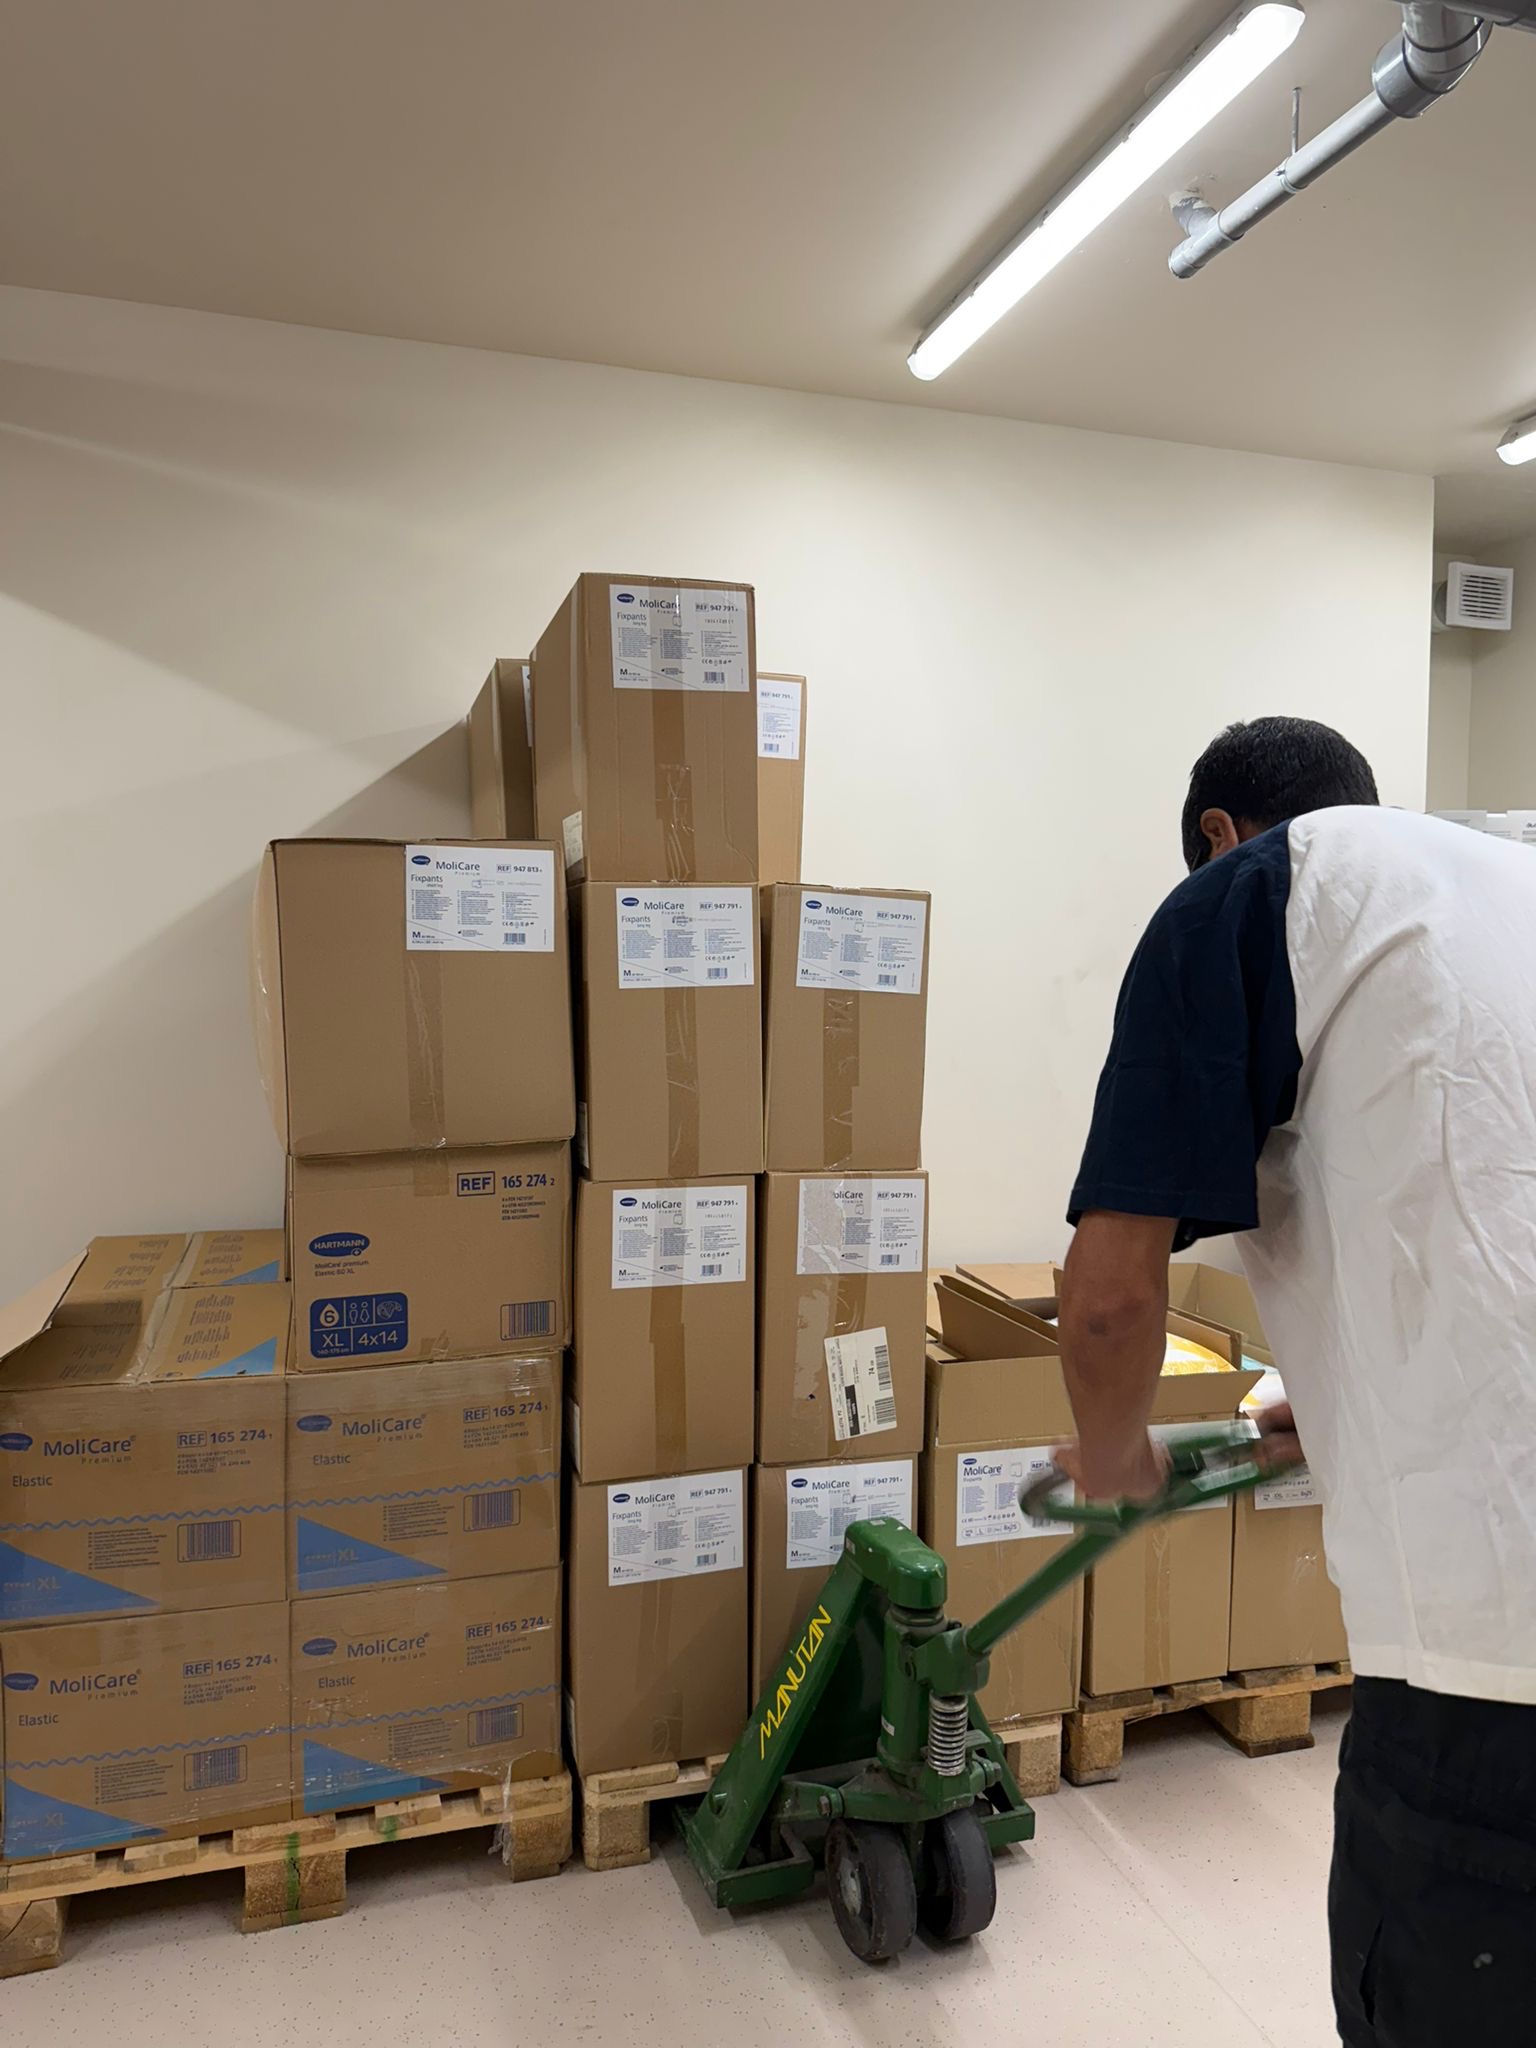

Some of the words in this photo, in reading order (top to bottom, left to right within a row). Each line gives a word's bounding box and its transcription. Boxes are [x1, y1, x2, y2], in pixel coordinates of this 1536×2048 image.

[617, 612, 647, 621] Fixpants
[436, 861, 480, 871] MoliCare
[411, 874, 443, 884] Fixpants
[644, 901, 685, 910] MoliCare
[826, 906, 863, 916] MoliCare
[621, 915, 651, 924] Fixpants
[804, 917, 831, 926] Fixpants
[412, 931, 421, 939] M
[502, 1175, 522, 1188] 165
[526, 1174, 547, 1187] 274
[833, 1191, 864, 1199] oliCare
[641, 1200, 682, 1210] MoliCare
[618, 1215, 648, 1224] Fixpants
[314, 1239, 365, 1249] HARTMANN
[324, 1310, 335, 1323] 6
[323, 1333, 344, 1347] XL
[358, 1330, 398, 1346] 4x14
[465, 1408, 488, 1421] REF
[493, 1405, 515, 1417] 165
[519, 1401, 542, 1414] 274
[342, 1416, 423, 1437] MoliCare
[179, 1433, 205, 1445] REF
[210, 1431, 235, 1443] 165
[240, 1429, 266, 1441] 274
[377, 1433, 423, 1443] Premium
[44, 1438, 131, 1457] MoliCare
[81, 1456, 132, 1465] Premium
[312, 1453, 351, 1466] Elastic
[963, 1465, 1002, 1477] MoliCare
[12, 1475, 53, 1488] Elastic
[812, 1480, 850, 1490] MoliCare
[635, 1493, 676, 1505] MoliCare
[791, 1496, 819, 1505] Fixpants
[612, 1510, 642, 1521] Fixpants
[613, 1566, 621, 1574] M
[468, 1625, 491, 1638] REF
[495, 1621, 517, 1633] 165
[521, 1616, 544, 1629] 274
[347, 1636, 426, 1658] MoliCare
[381, 1653, 427, 1664] Premium
[185, 1662, 211, 1675] REF
[216, 1659, 240, 1671] 165
[246, 1654, 271, 1667] 274
[50, 1672, 137, 1695] MoliCare
[318, 1674, 356, 1689] Elastic
[759, 1604, 832, 1761] MANUTAN
[87, 1690, 139, 1700] Premium
[18, 1713, 59, 1727] Elastic
